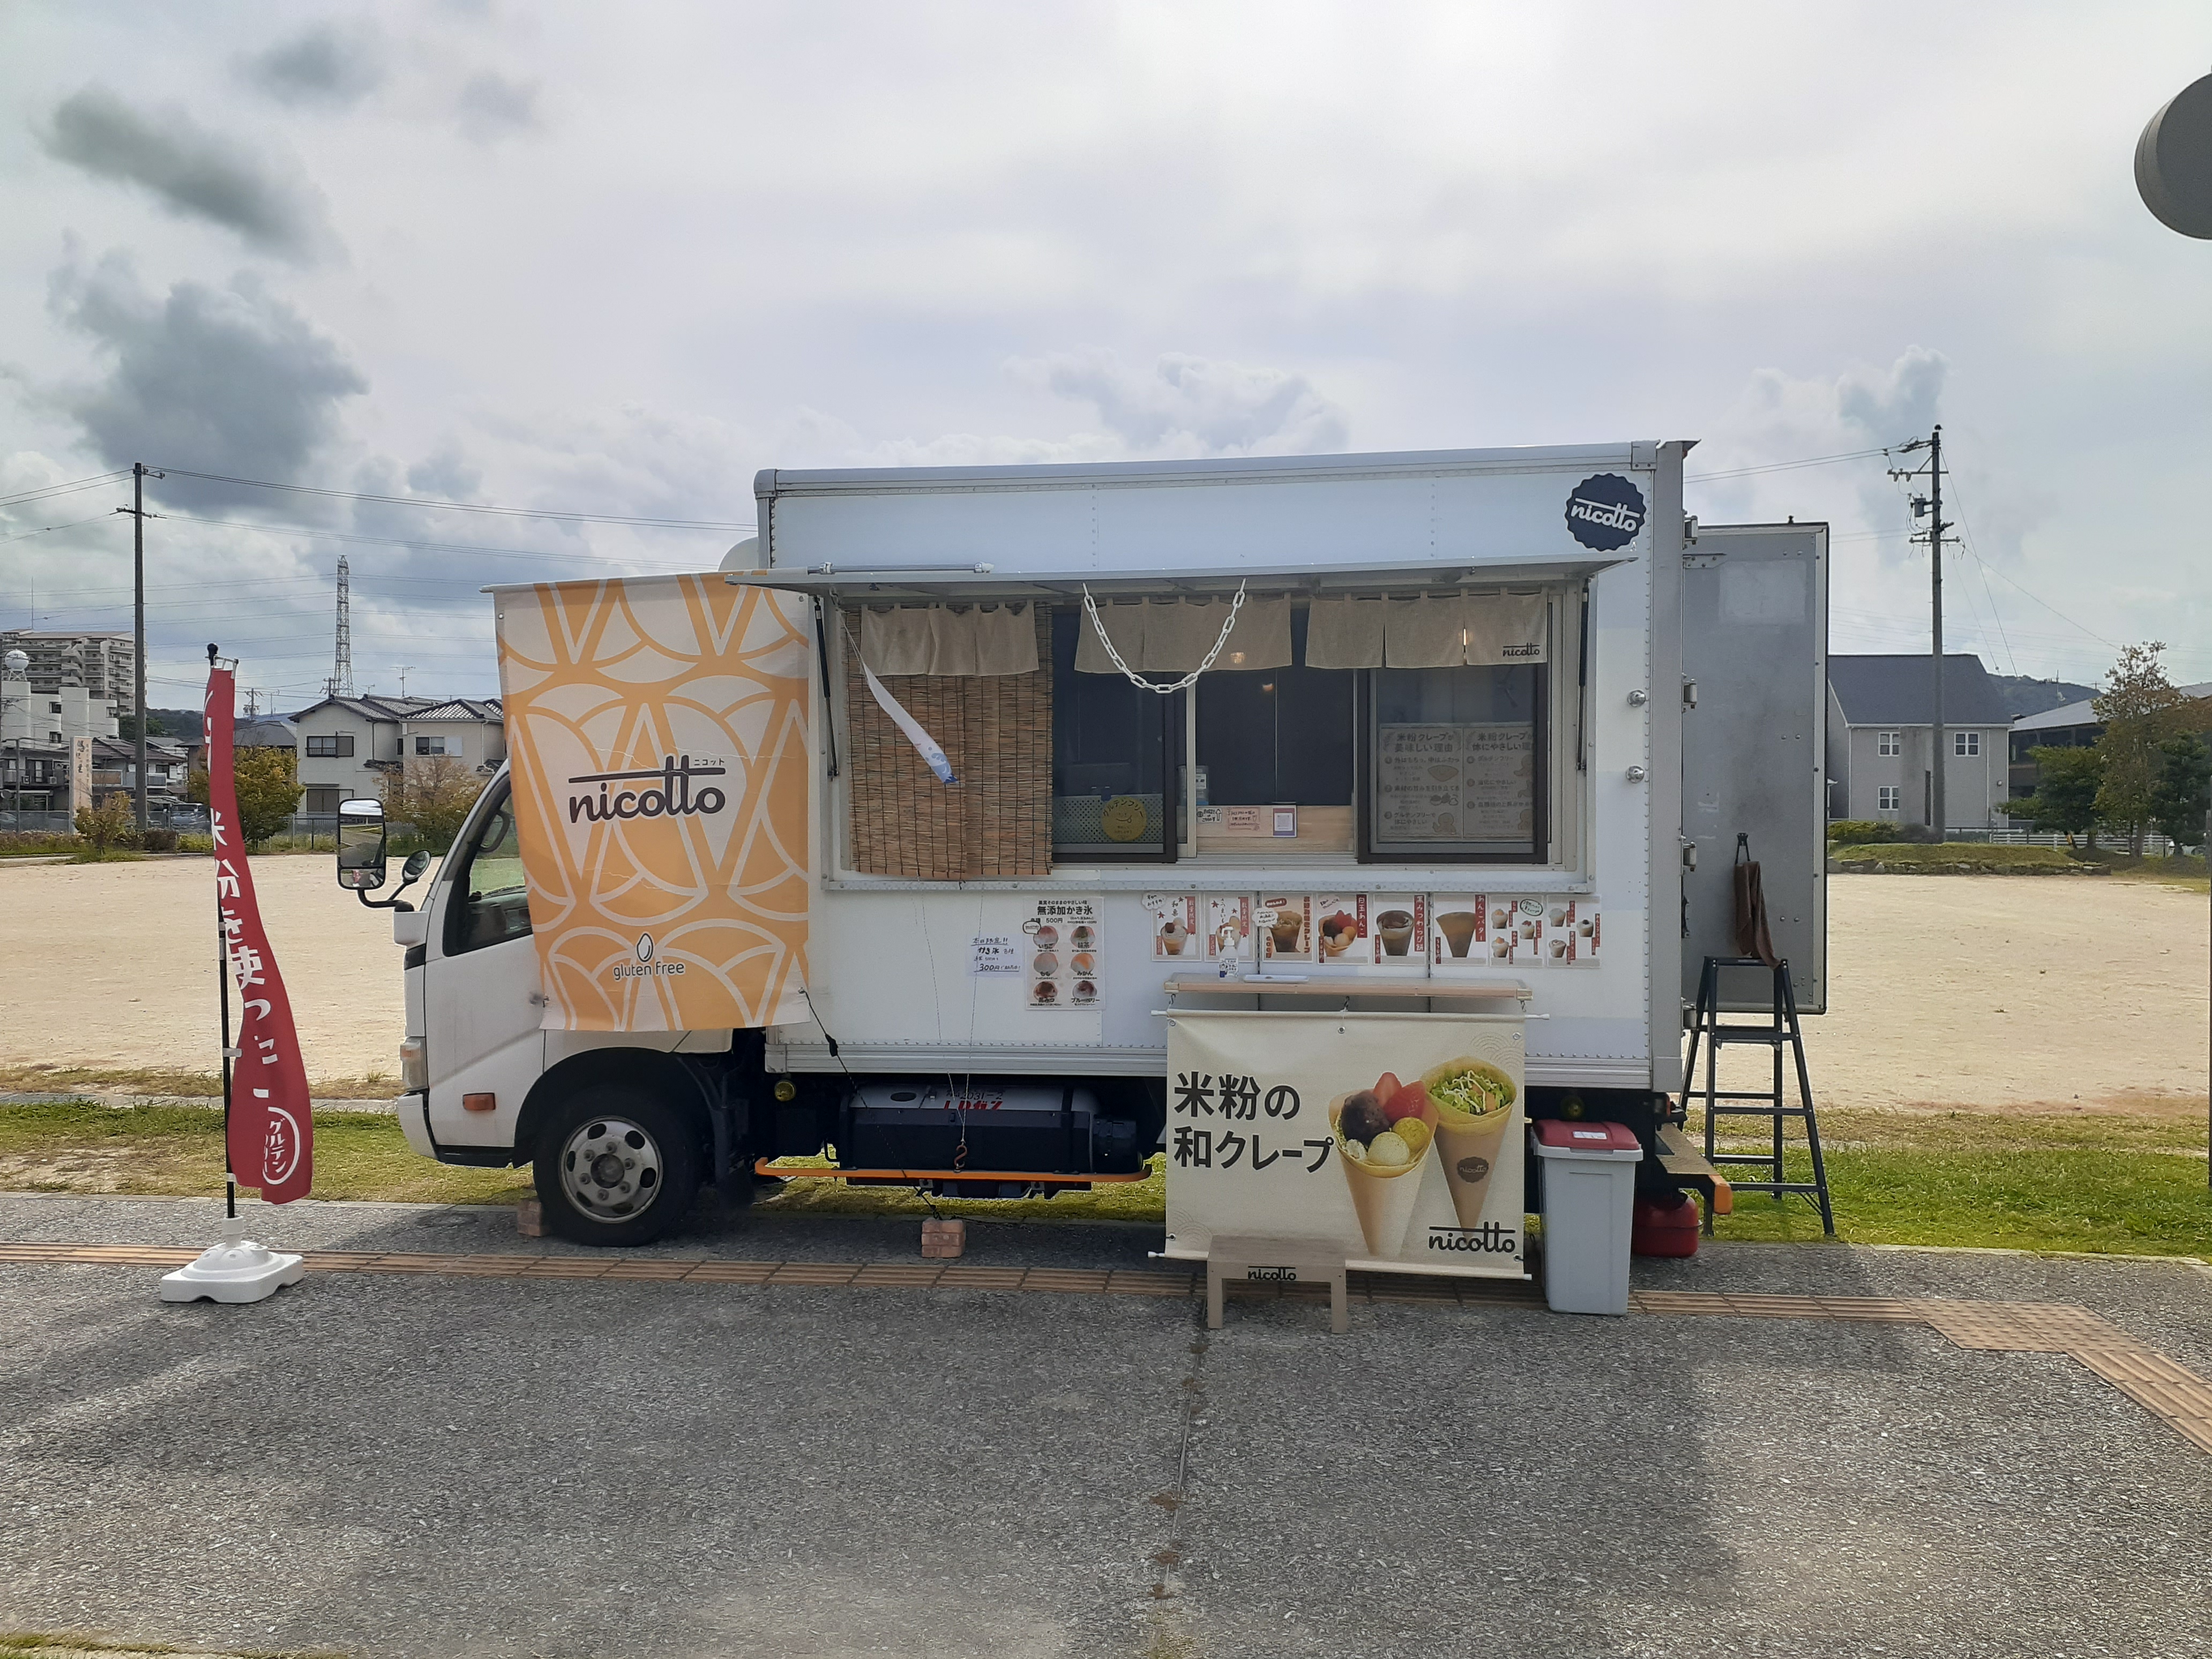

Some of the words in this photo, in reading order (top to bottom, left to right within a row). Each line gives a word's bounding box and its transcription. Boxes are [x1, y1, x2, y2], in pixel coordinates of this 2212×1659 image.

[1571, 498, 1640, 532] nicotto
[1503, 642, 1540, 657] nicotto
[693, 757, 725, 767] ニコット
[568, 754, 726, 824] nicotto
[1037, 905, 1093, 915] 無添加かき氷
[1416, 895, 1424, 951] 黒みつわらび餅
[613, 961, 653, 980] gluten
[655, 961, 685, 975] free
[1174, 1070, 1301, 1120] 米粉の
[269, 1118, 286, 1174] グルテン
[1174, 1125, 1334, 1173] 和クレープ
[1428, 1221, 1516, 1253] nicotto
[1247, 1265, 1297, 1281] nicotto
